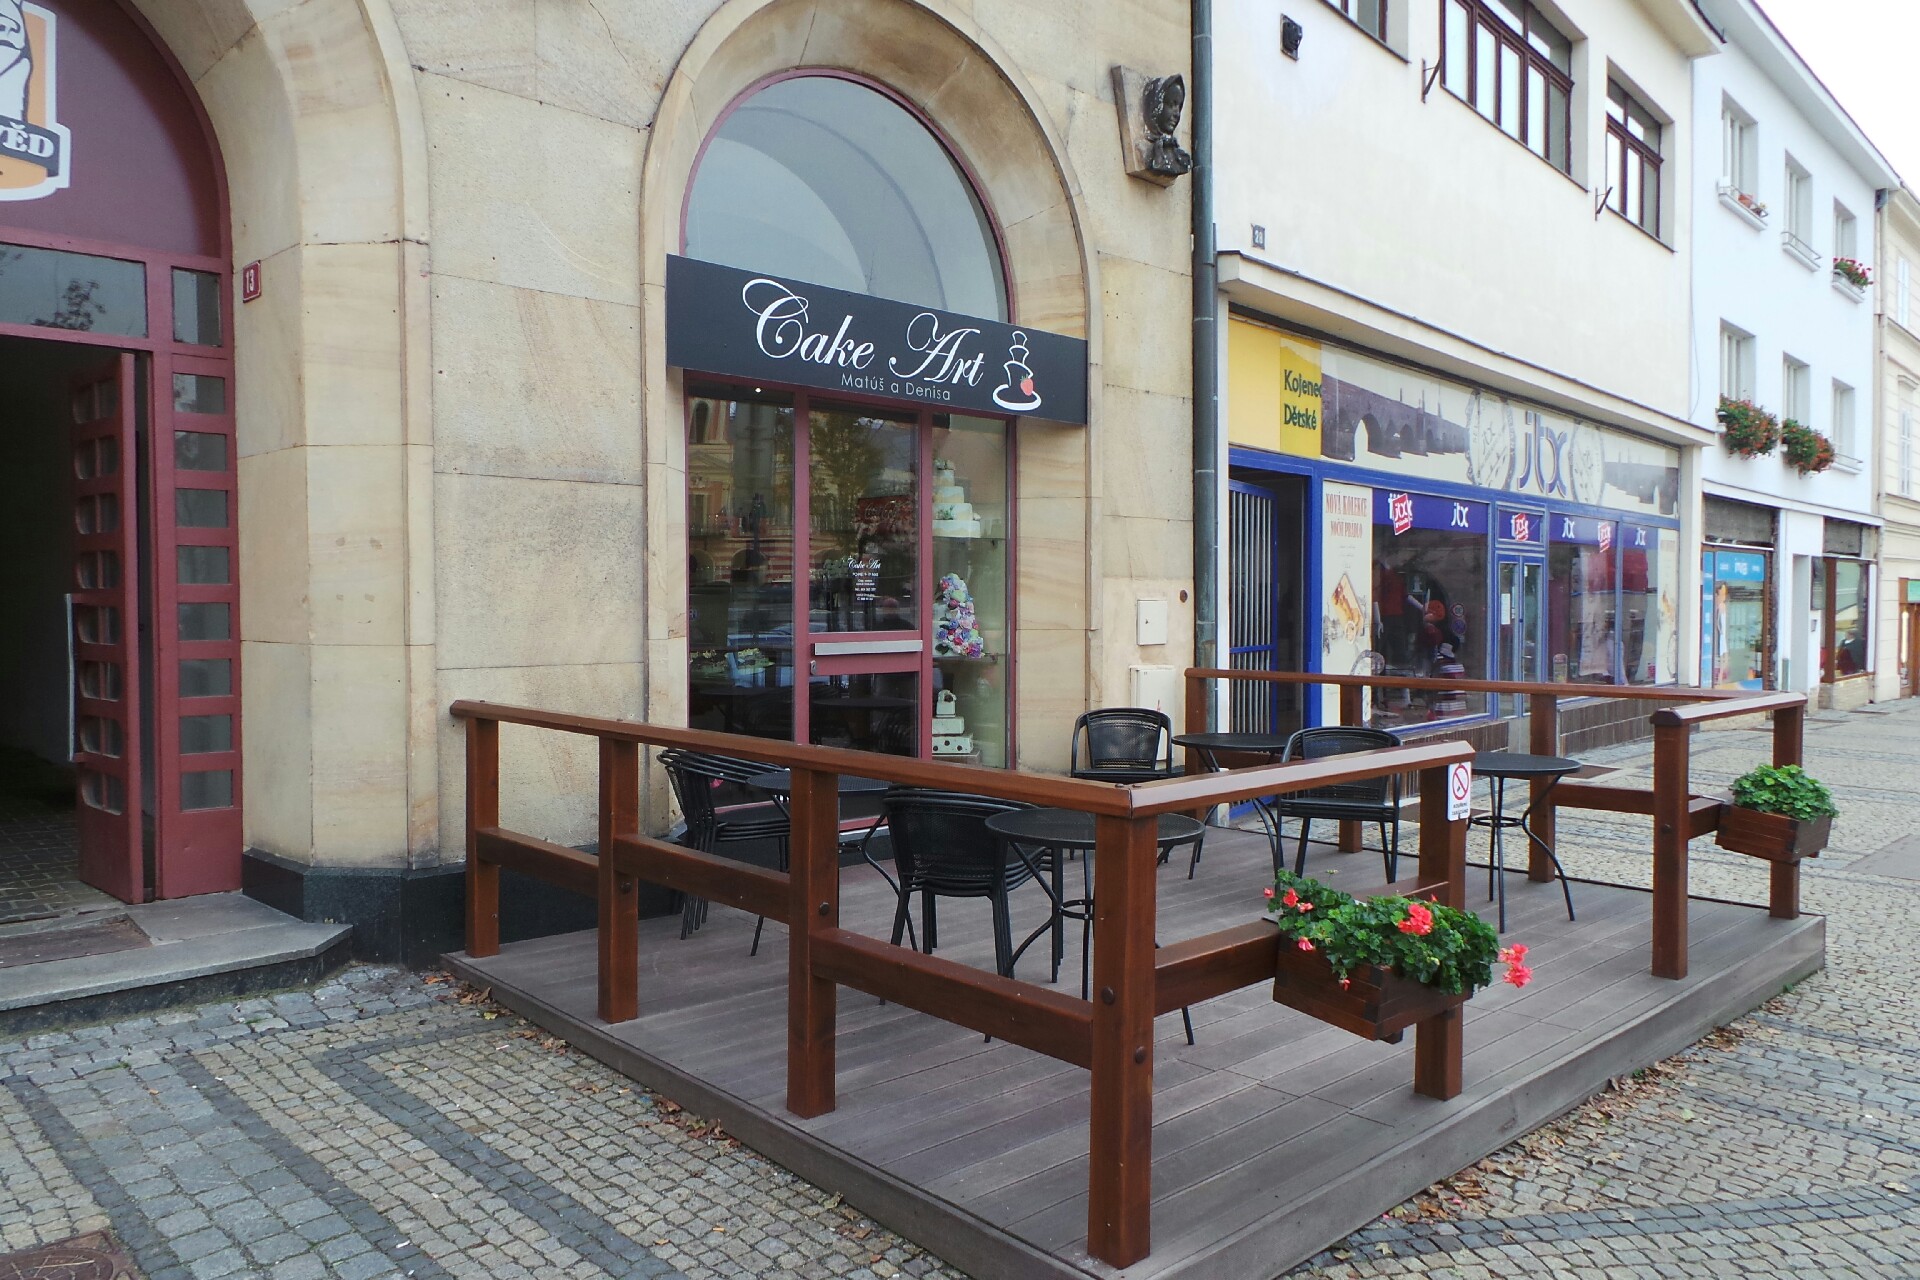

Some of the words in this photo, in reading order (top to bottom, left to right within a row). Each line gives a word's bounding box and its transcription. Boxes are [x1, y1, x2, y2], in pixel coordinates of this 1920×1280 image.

[0, 121, 54, 157] ĚD
[742, 278, 875, 369] Cake
[888, 312, 985, 387] Art
[841, 372, 884, 391] Matúš
[891, 383, 899, 393] a
[905, 382, 951, 400] Denisa
[1284, 402, 1317, 430] Dětské
[1517, 410, 1568, 499] jtx
[1451, 502, 1469, 528] jtx
